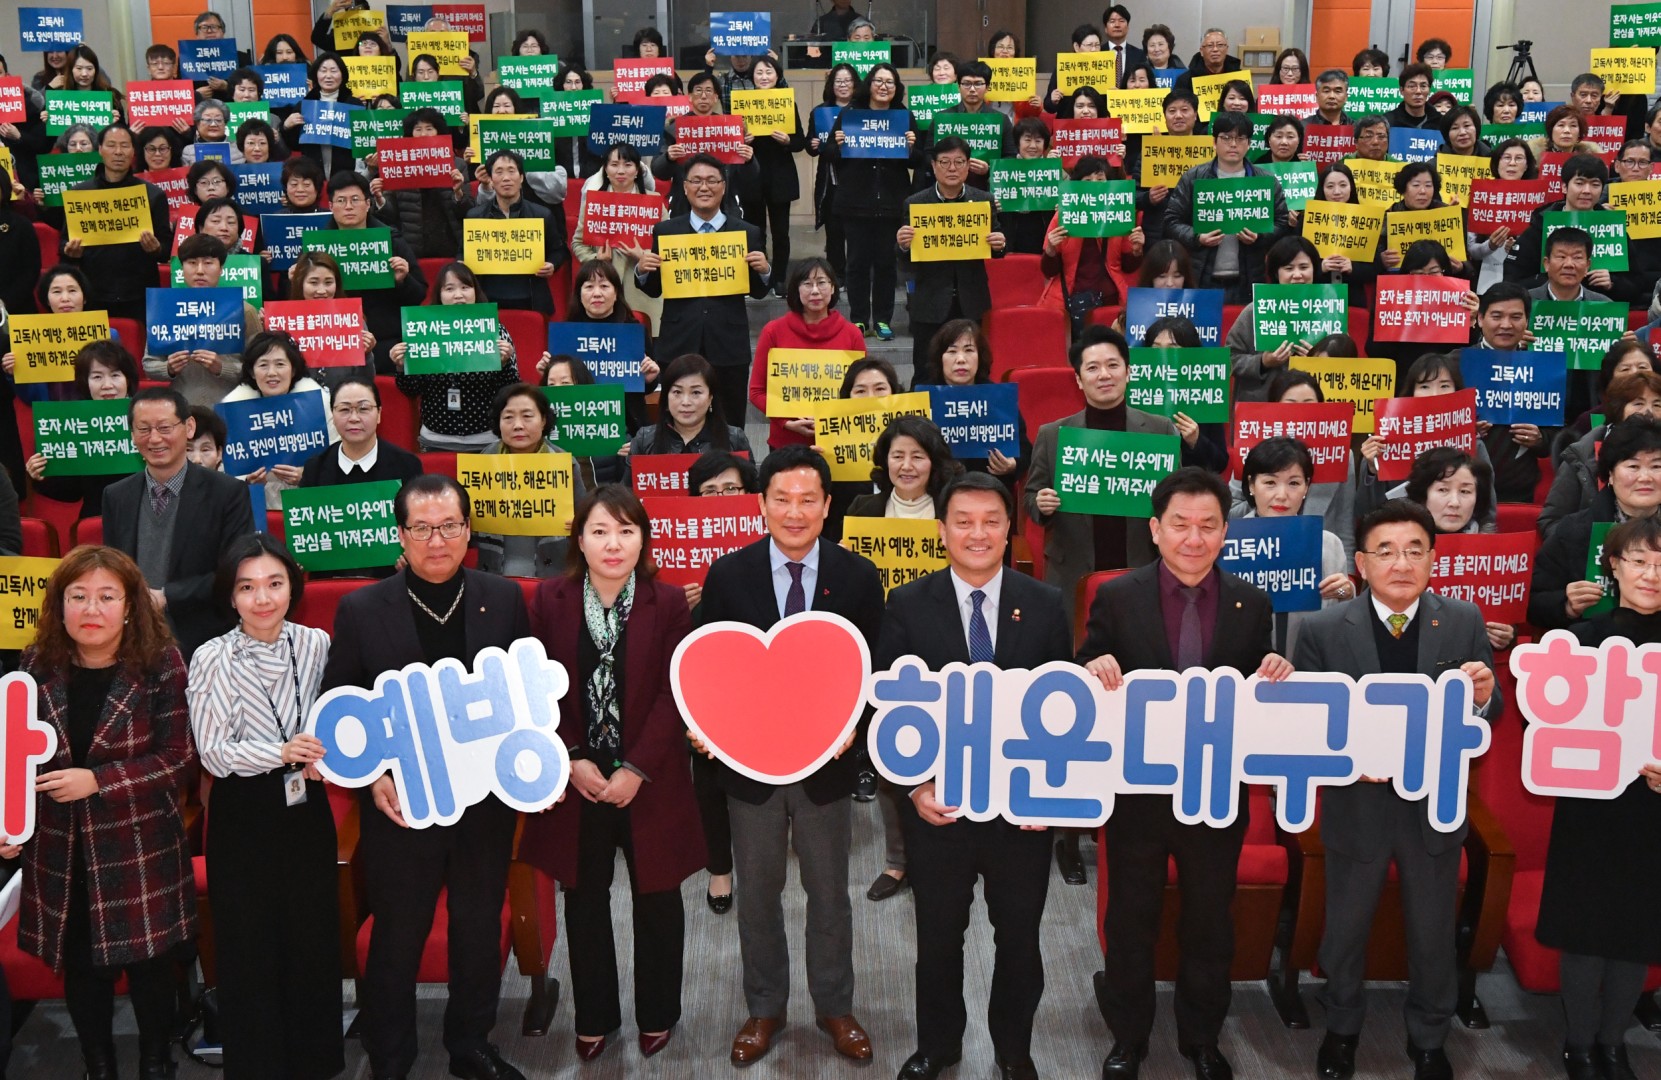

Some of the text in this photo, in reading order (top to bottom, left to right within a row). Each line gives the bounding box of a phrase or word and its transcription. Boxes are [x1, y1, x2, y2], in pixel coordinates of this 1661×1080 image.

[38, 17, 64, 27] 고독사!
[728, 21, 752, 31] 고독사!
[23, 32, 82, 44] 이웃, 당신이 희망입니다
[713, 36, 768, 46] 이웃, 당신이 희망입니다
[1593, 58, 1653, 68] 고독사 예방, 해운대가
[1615, 73, 1646, 84] 하겠습니다
[130, 90, 192, 102] 혼자 눈물 흘리지 마세요
[131, 104, 192, 116] 당신은 혼자가 아닙니다
[862, 120, 889, 131] 고독사!
[859, 136, 906, 148] 당신이 희망입니다
[381, 147, 450, 162] 혼자 눈물 흘리지 마세요
[383, 164, 451, 178] 당신은 혼자가 아닙니다
[993, 170, 1059, 182] 혼자 사는 이웃에게
[994, 186, 1059, 202] 관심을 가져주세요
[1197, 189, 1271, 204] 혼자 사는 이웃에게
[67, 196, 145, 214] 고독사 예방, 해운대가
[913, 214, 988, 228] 고독사 예방, 해운대가
[1198, 207, 1269, 221] 관심을 가져주세요
[80, 217, 139, 233] 함께 하겠습니다
[923, 234, 978, 248] 함께 하겠습니다
[662, 245, 744, 264] 고독사 예방, 해운대가
[674, 266, 735, 284] 함께 하겠습니다
[1380, 290, 1440, 304] 혼자 눈물 흘리지
[176, 301, 214, 317] 고독사!
[1155, 303, 1194, 318] 고독사!
[1258, 299, 1344, 314] 혼자 사는 이웃에게
[269, 313, 359, 331] 혼자 눈물 흘리지 마세요
[406, 318, 495, 336] 혼자 사는 이웃에게
[1260, 320, 1342, 335] 관심을 가져주세요
[1379, 311, 1466, 327] 당신은 혼자가 아닙니다
[1534, 315, 1624, 332] 혼자 사는 이웃에게
[13, 324, 107, 344] 고독사 예방, 해운대가
[152, 324, 240, 341] 이웃, 당신이 희망입니다
[299, 335, 360, 351] 혼자가 아닙니다
[409, 340, 495, 358] 관심을 가져주세요
[577, 338, 615, 353] 고독사!
[1533, 337, 1564, 352] 관심을
[26, 352, 47, 367] 함께
[600, 361, 640, 377] 희망입니다
[1130, 364, 1226, 382] 혼자 사는 이웃에게
[1491, 365, 1533, 383] 고독사!
[1324, 372, 1392, 390] 예방, 해운대가
[1130, 388, 1224, 405] 관심을 가져주세요
[1486, 390, 1560, 409] 당신이 희망입니다
[575, 400, 621, 416] 이웃에게
[945, 400, 987, 418] 고독사!
[38, 418, 88, 435] 혼자 사는
[249, 410, 293, 430] 고독사!
[820, 414, 880, 435] 고독사 예방,
[1379, 407, 1472, 436] 혼자 눈물 흘리지 마세요
[566, 423, 620, 439] 가져주세요
[941, 424, 1014, 443] 당신이 희망입니다
[1239, 420, 1347, 439] 혼자 눈물 흘리지 마세요
[41, 442, 77, 461] 관심을
[226, 431, 324, 460] 이웃, 당신이 희망입니다
[834, 445, 857, 464] 함께
[1062, 446, 1174, 472] 혼자 사는 이웃에게
[461, 470, 569, 490] 고독사 예방, 해운대가
[1061, 473, 1100, 494] 관심을
[289, 505, 343, 526] 혼자 사는
[474, 499, 555, 518] 함께 하겠습니다
[650, 517, 736, 538] 혼자 눈물 흘리지
[293, 526, 400, 552] 관심을 가져주세요
[848, 537, 918, 558] 고독사 예방,
[1222, 537, 1279, 560] 고독사!
[653, 548, 686, 568] 당신은
[1454, 553, 1528, 575] 흘리지 마세요
[1257, 568, 1316, 592] 희망입니다
[1478, 583, 1525, 605] 아닙니다
[315, 643, 562, 820] 예방
[875, 664, 1483, 825] 해운대구가
